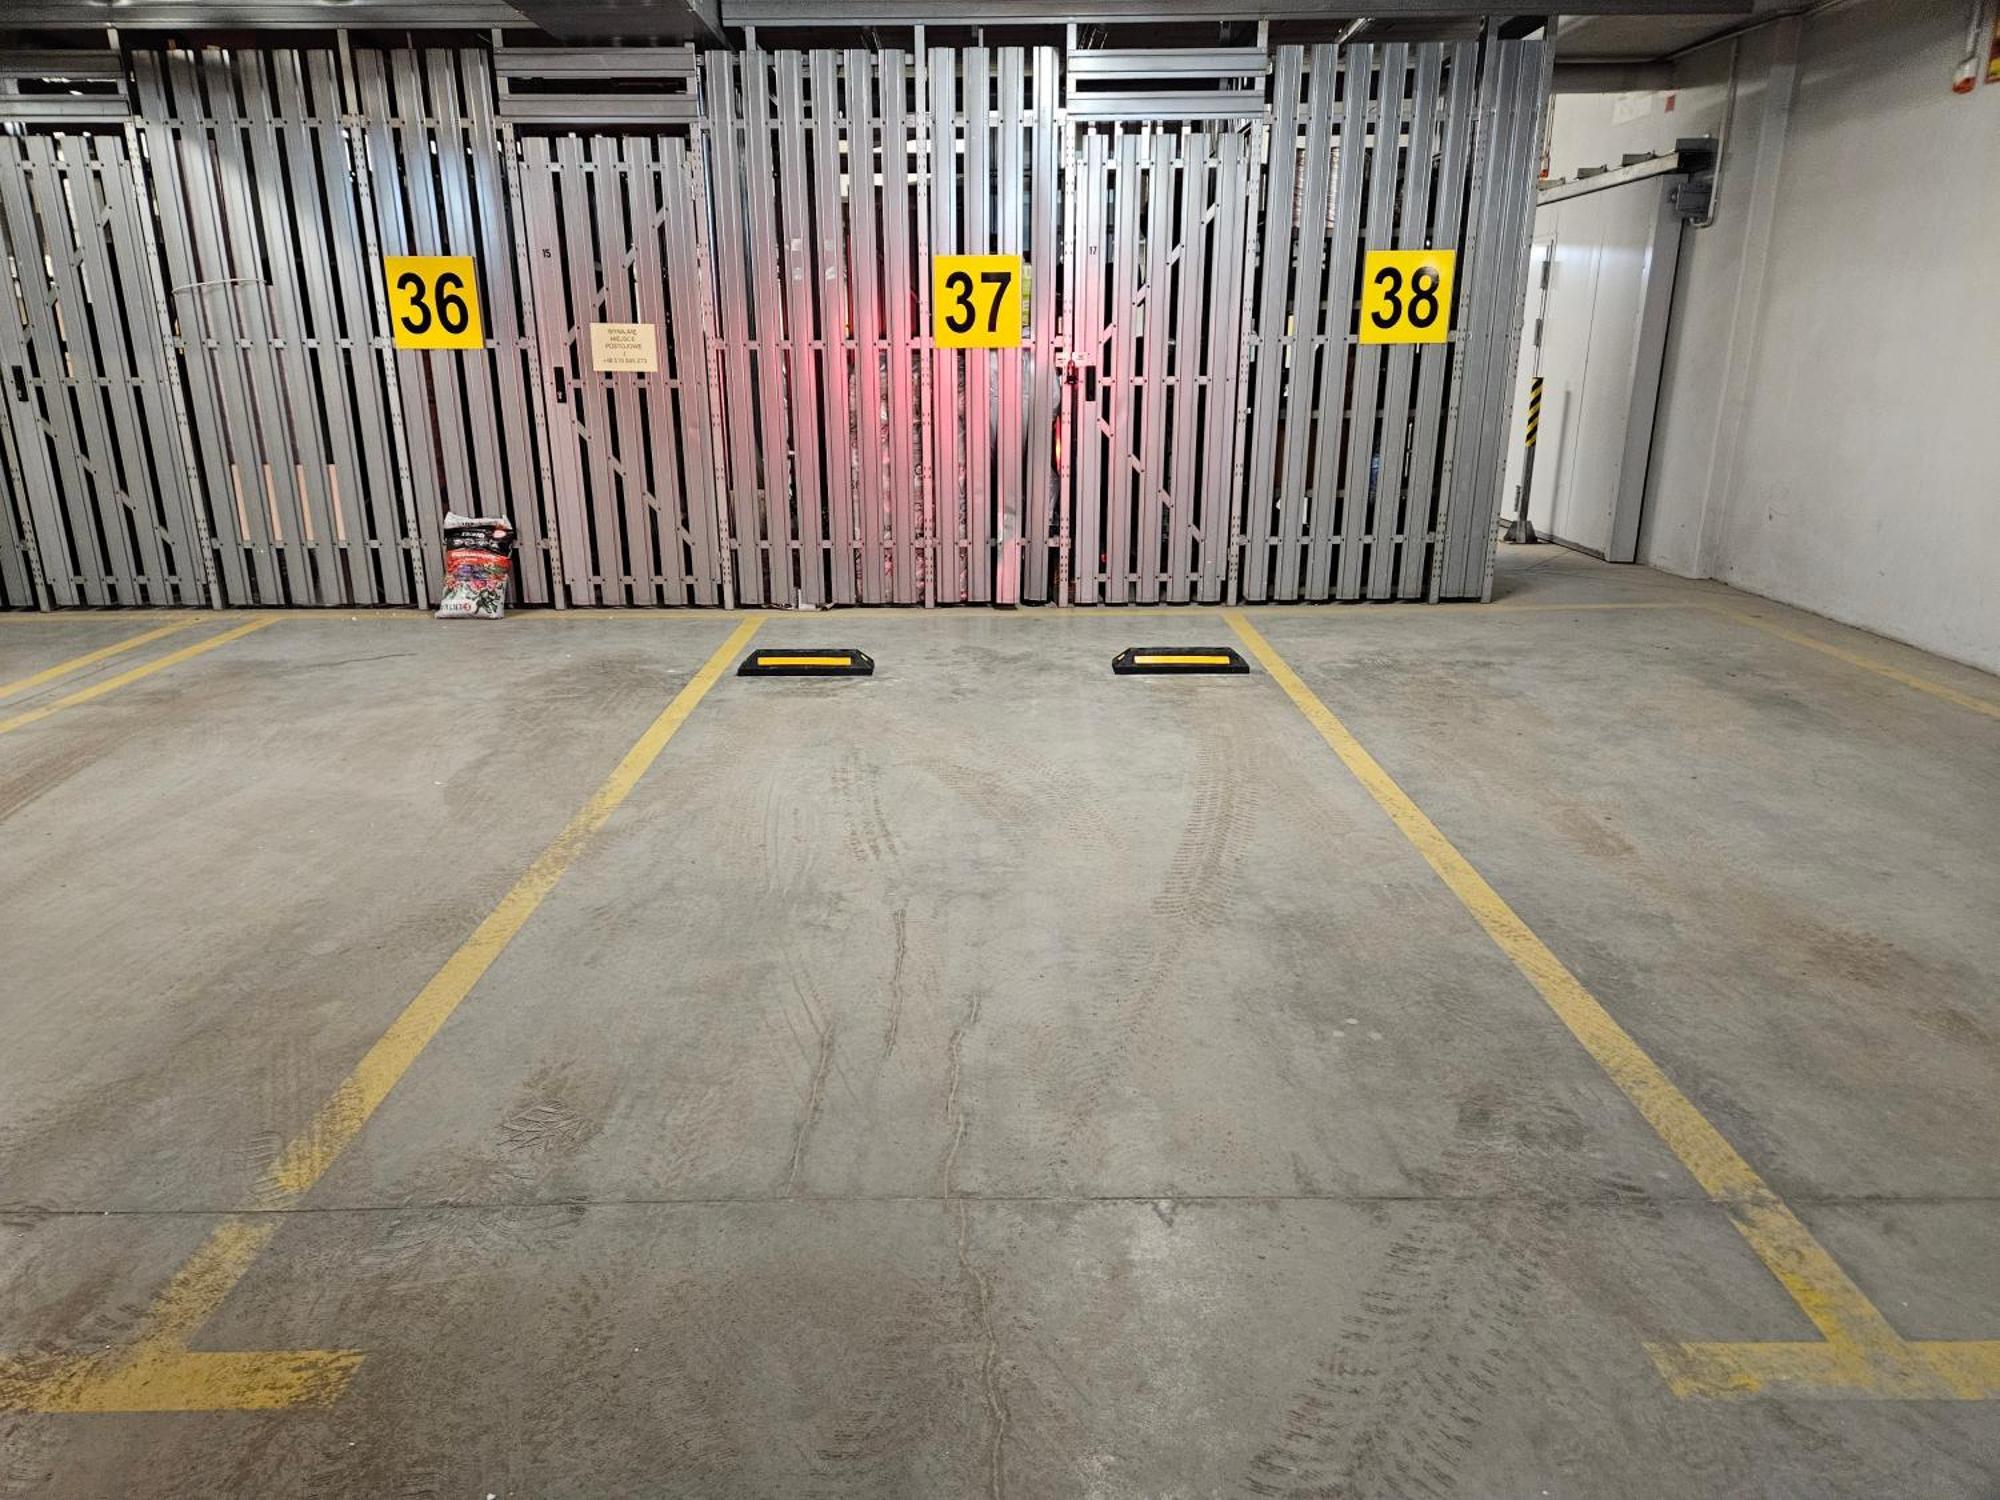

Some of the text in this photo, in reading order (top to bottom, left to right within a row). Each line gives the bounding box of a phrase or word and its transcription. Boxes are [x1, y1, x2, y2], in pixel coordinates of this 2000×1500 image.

[542, 248, 551, 258] 15
[1089, 246, 1097, 255] 17
[397, 272, 469, 334] 36
[946, 271, 1011, 334] 37
[1371, 267, 1439, 329] 38
